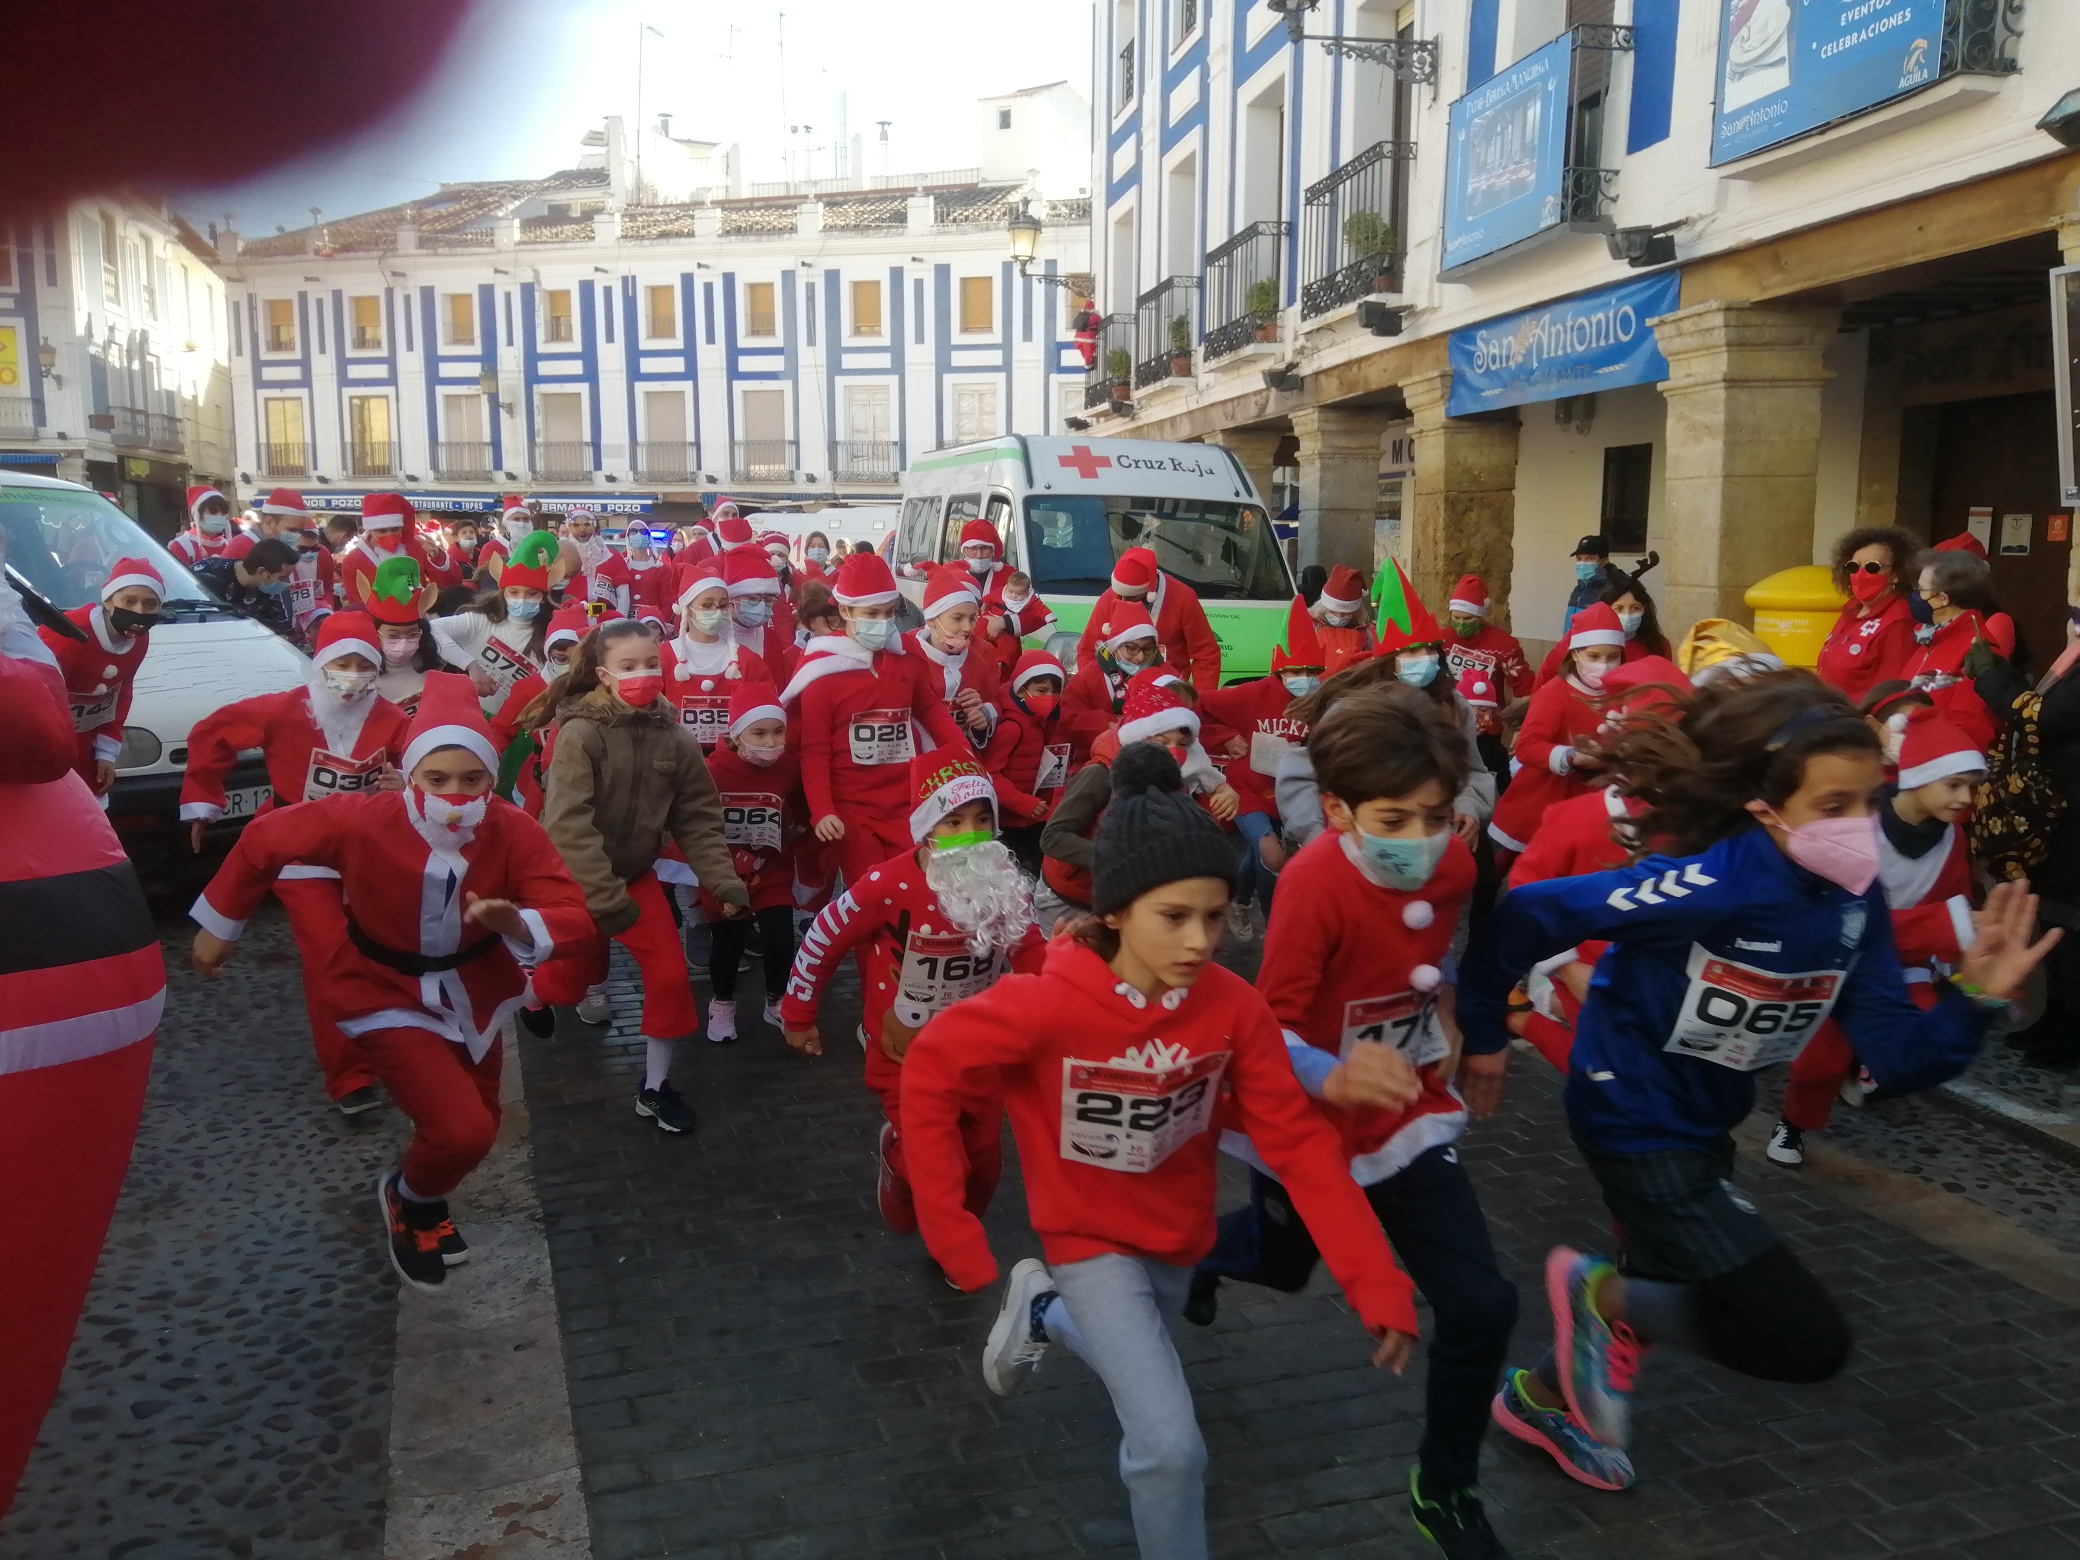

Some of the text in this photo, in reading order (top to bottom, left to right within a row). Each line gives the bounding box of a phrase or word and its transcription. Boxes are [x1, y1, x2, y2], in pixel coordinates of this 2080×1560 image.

[1820, 7, 1912, 59] CELEBRACIONES
[1720, 121, 1740, 139] San
[1744, 98, 1788, 131] Antonio
[1473, 298, 1636, 374] San Antonio
[1116, 454, 1167, 471] Cruz
[331, 499, 362, 508] POZO
[462, 501, 483, 510] TAPAS
[541, 503, 641, 512] ERMANOS POZO
[597, 580, 616, 597] 25
[683, 709, 729, 725] 035
[854, 722, 908, 742] 028
[951, 779, 987, 795] Feliz
[723, 807, 781, 829] 064
[786, 889, 861, 1002] SANTA
[1696, 986, 1823, 1035] 065
